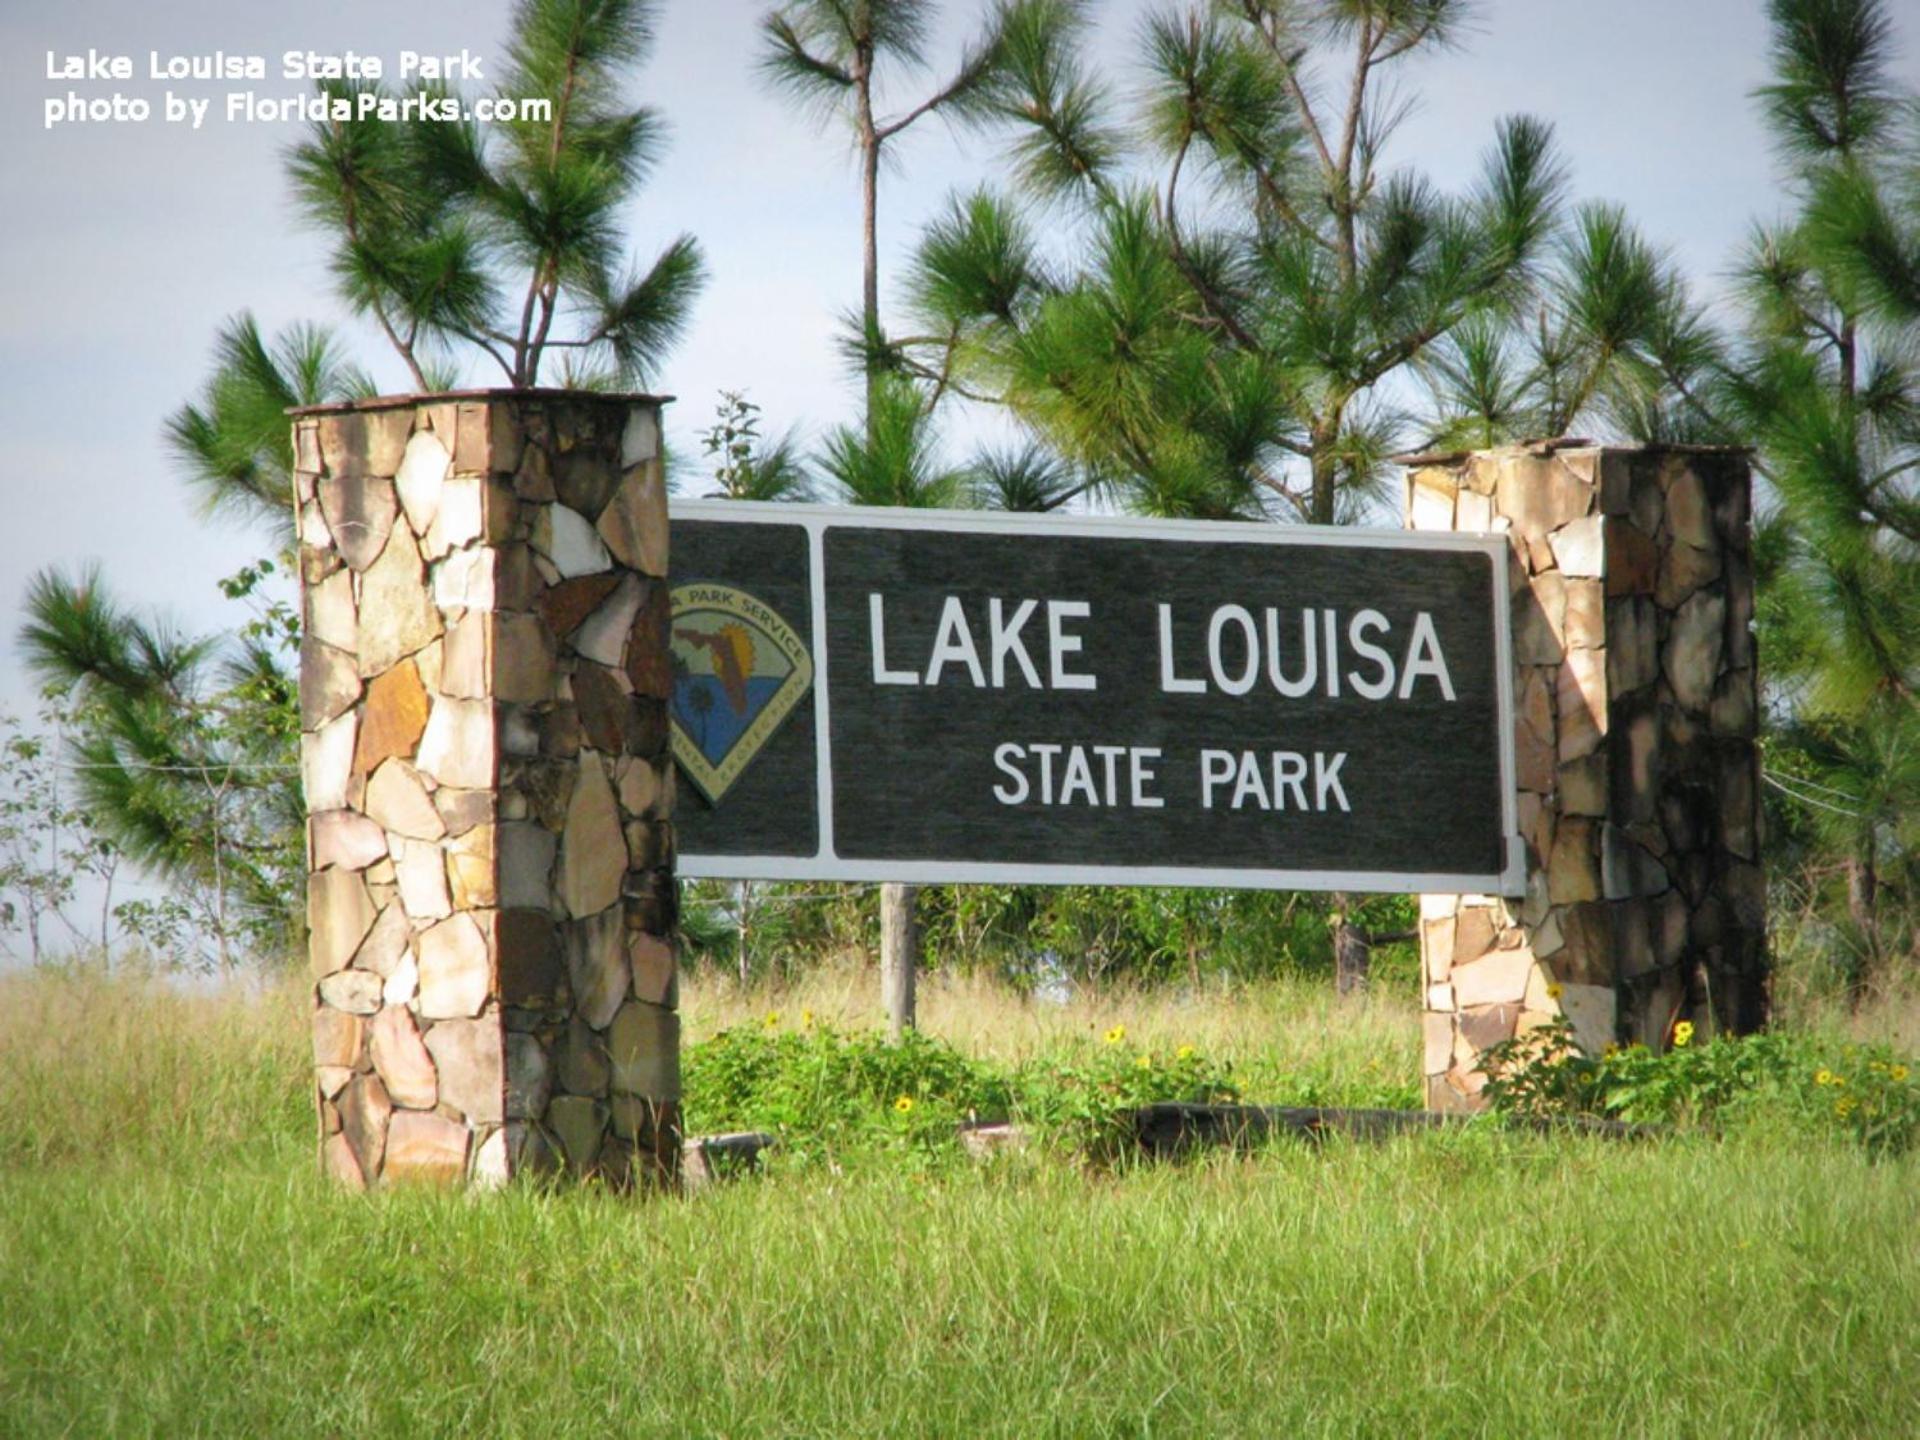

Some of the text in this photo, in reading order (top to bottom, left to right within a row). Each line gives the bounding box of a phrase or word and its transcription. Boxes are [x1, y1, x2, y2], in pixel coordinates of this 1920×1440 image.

[688, 590, 806, 662] PARK SERVICE
[868, 592, 1457, 702] LAKE LOUISA
[992, 742, 1351, 812] STATE PARK
